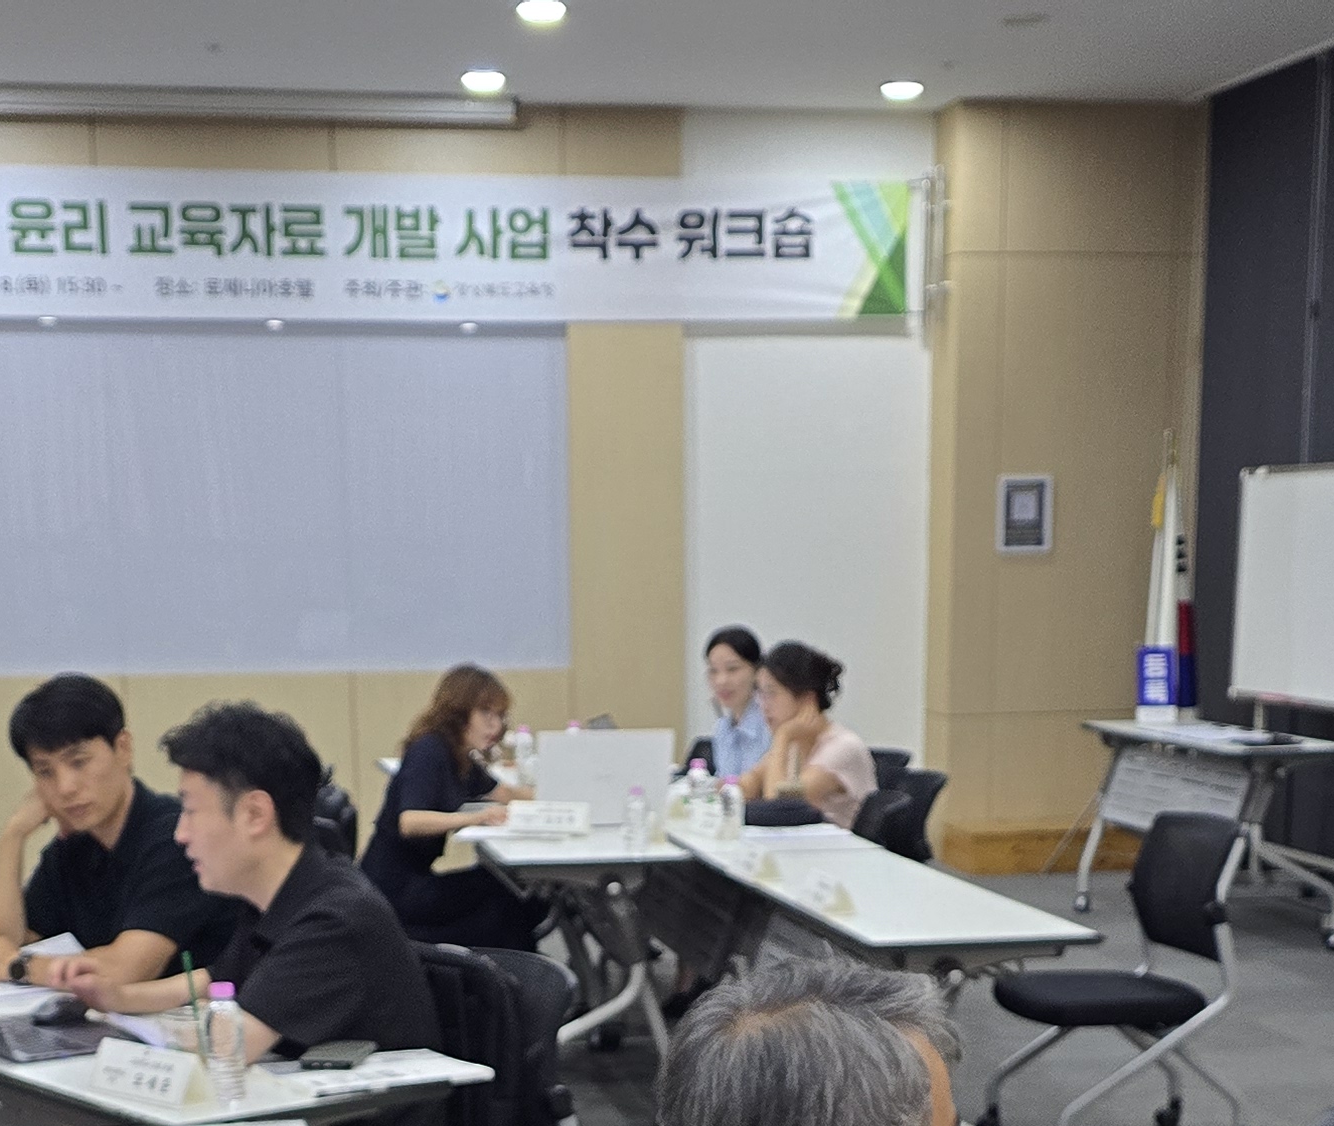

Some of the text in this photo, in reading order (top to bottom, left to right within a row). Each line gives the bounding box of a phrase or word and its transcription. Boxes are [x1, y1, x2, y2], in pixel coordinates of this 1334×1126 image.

[8, 198, 111, 258] 윤리
[127, 200, 327, 260] 교육자료
[341, 202, 441, 262] 개발
[454, 204, 552, 262] 사업
[568, 206, 660, 262] 착수
[674, 206, 814, 262] 워크숍
